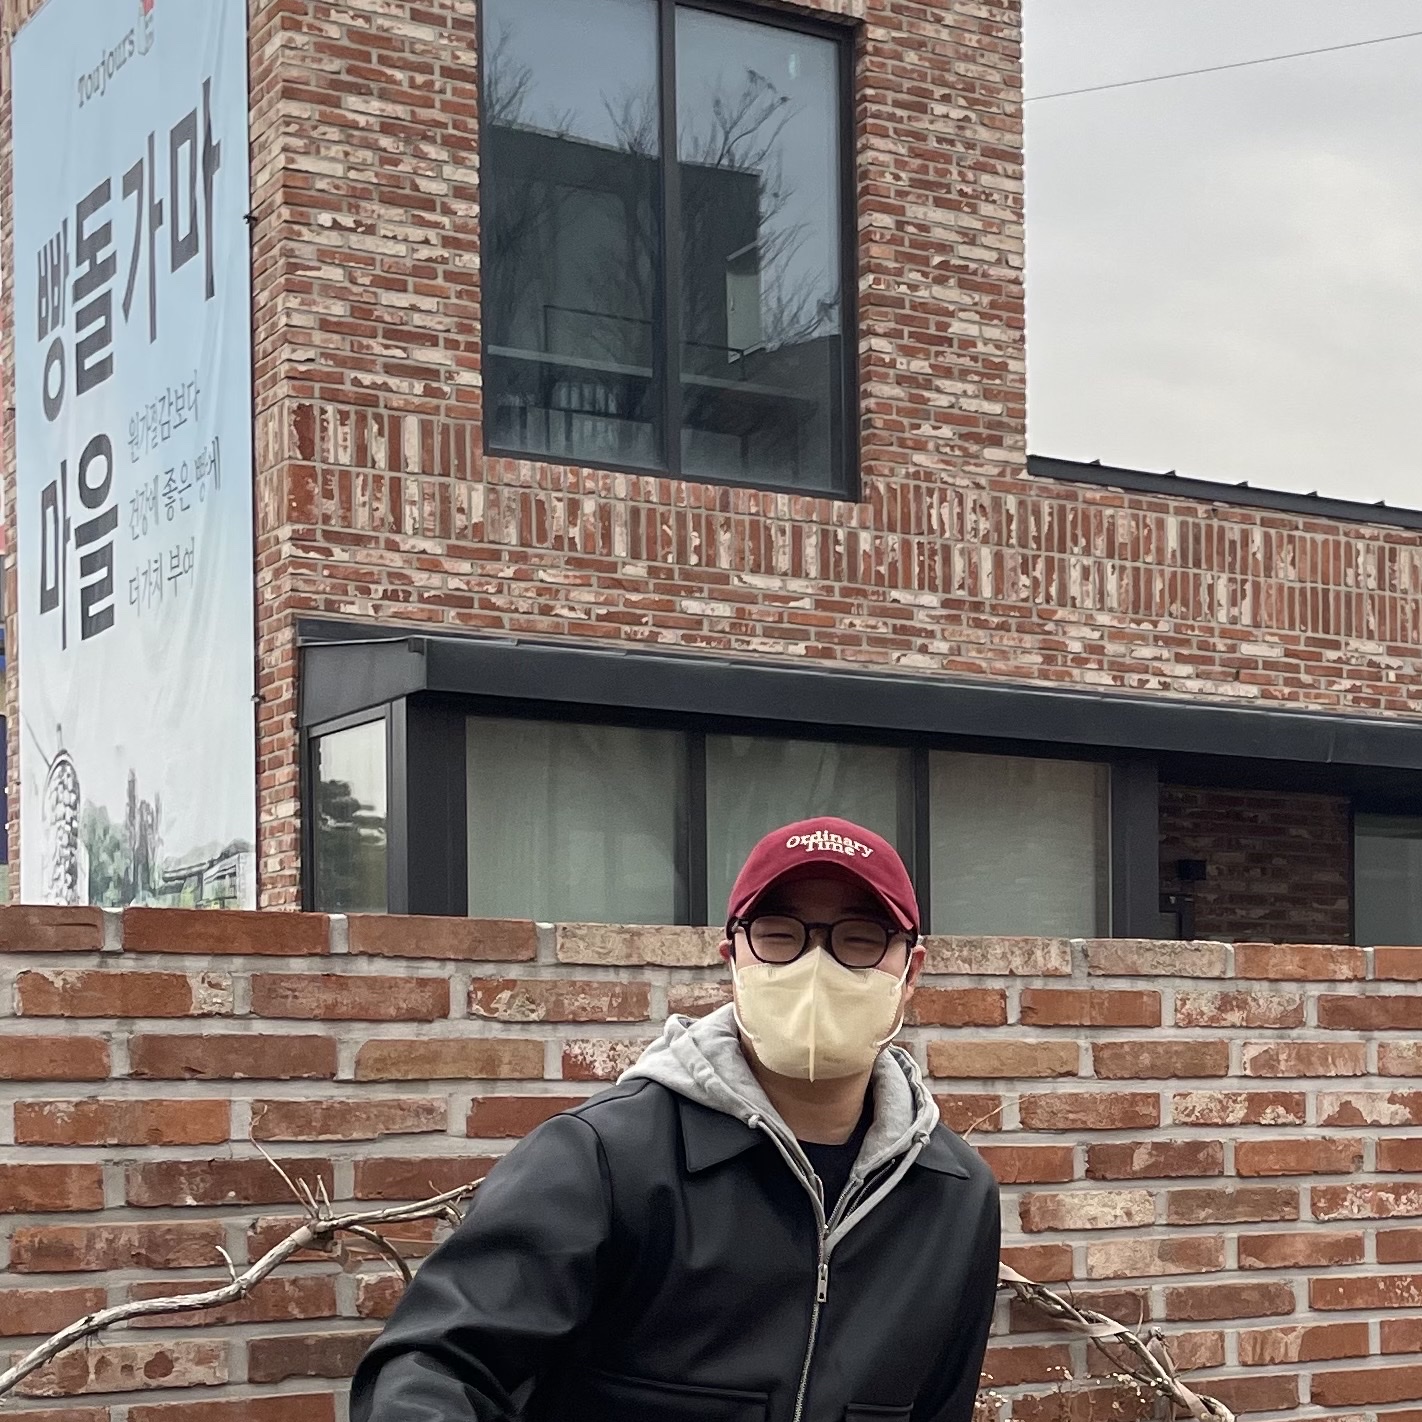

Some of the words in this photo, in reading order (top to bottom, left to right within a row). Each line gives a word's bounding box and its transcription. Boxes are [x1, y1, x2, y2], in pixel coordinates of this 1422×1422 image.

[37, 75, 221, 422] 빵돌가마
[162, 459, 193, 522] 좋은
[39, 433, 119, 651] 마을
[167, 535, 196, 598] 부여
[785, 829, 874, 858] Ordinary
[805, 839, 856, 856] Time
